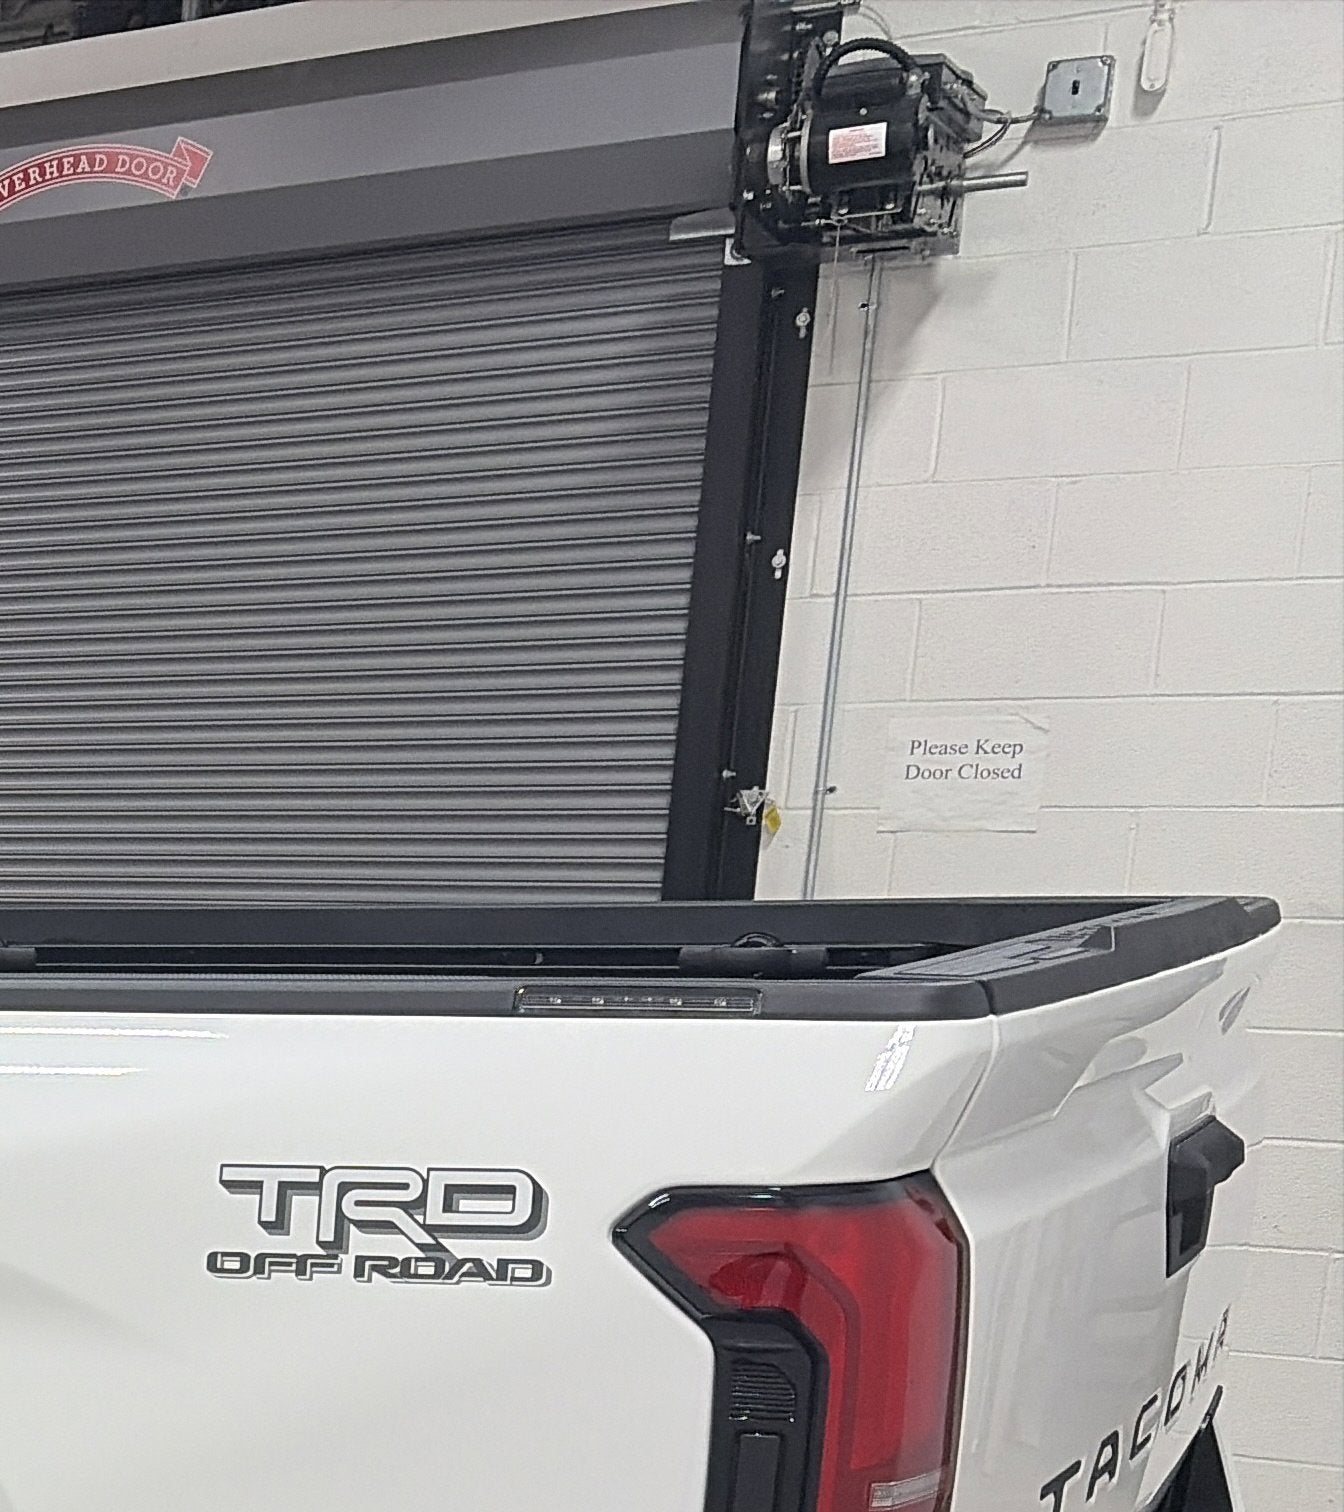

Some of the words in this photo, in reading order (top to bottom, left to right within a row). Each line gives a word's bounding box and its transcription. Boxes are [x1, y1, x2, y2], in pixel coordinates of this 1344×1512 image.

[115, 155, 178, 186] DOOR
[910, 739, 969, 756] Please
[974, 738, 1024, 758] Keep
[904, 764, 953, 780] Door
[957, 763, 1023, 780] Closed
[219, 1163, 549, 1256] TRD
[206, 1251, 343, 1281] OFF
[353, 1254, 553, 1287] ROAD
